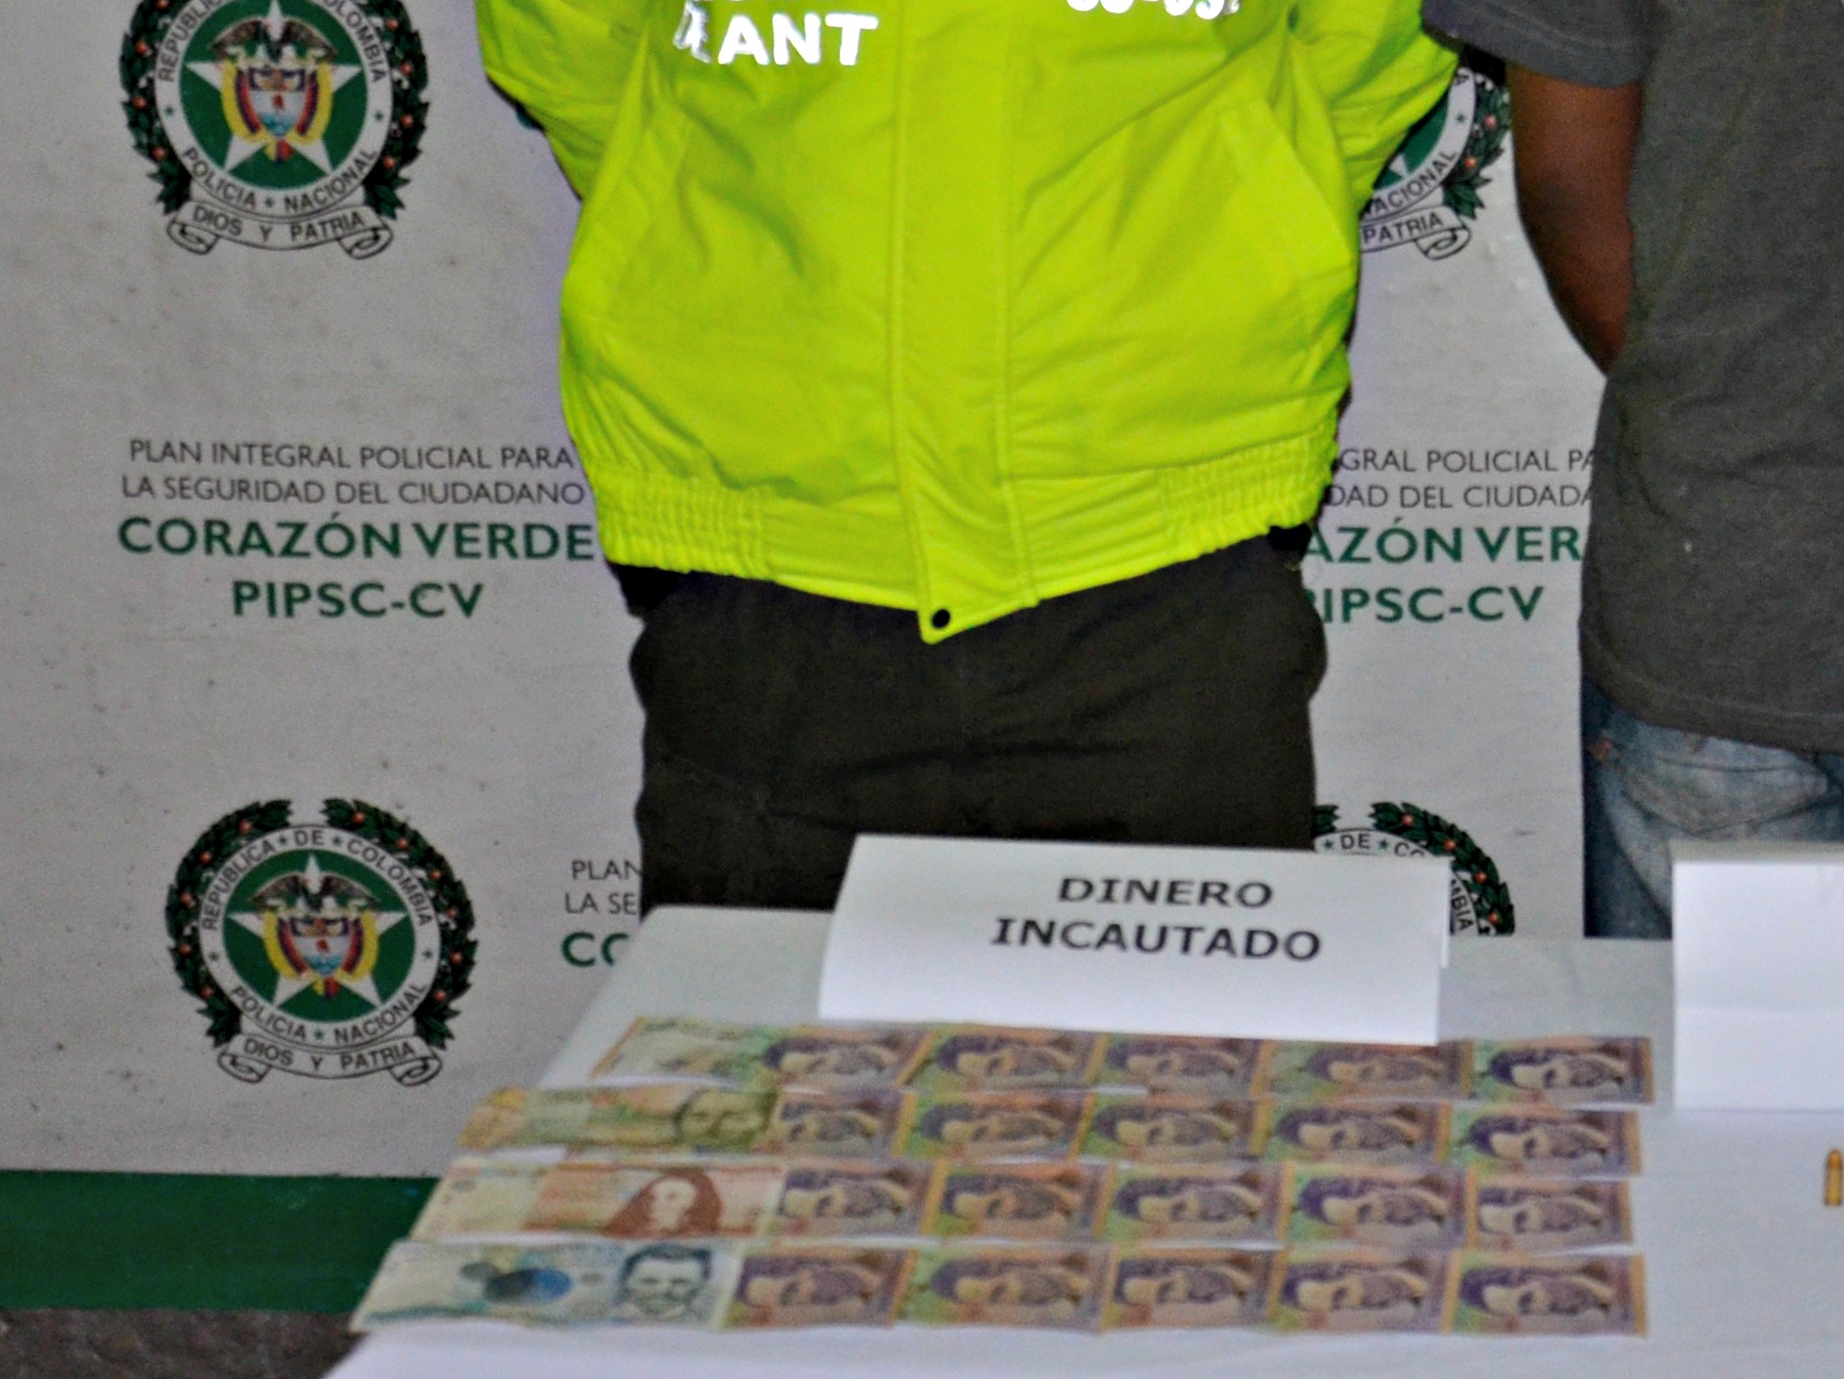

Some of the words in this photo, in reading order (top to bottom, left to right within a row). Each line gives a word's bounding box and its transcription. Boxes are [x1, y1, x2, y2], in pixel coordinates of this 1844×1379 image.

[183, 148, 256, 207] POLICIA
[285, 150, 376, 211] NACIONAL
[194, 206, 242, 235] DIOS
[291, 211, 364, 241] PATRIA
[1364, 213, 1443, 244] PATRIA
[130, 440, 200, 464] PLAN
[212, 443, 350, 469] INTEGRAL
[360, 446, 491, 470] POLICIAL
[500, 447, 575, 469] PARA
[1427, 450, 1557, 472] POLICIAL
[121, 477, 154, 498] LA
[164, 478, 325, 503] SEGURIDAD
[336, 482, 388, 504] DEL
[399, 483, 585, 505] CIUDADANO
[1401, 486, 1452, 508] DEL
[118, 512, 401, 558] CORAZÓN
[413, 523, 594, 561] VERDE
[232, 581, 484, 618] PIPSC-CV
[1341, 833, 1371, 849] DE
[203, 841, 275, 930] REPUBLICA
[295, 830, 325, 845] DE
[348, 839, 433, 926] COLOMBIA
[1058, 876, 1274, 907] DINERO
[566, 893, 599, 913] LA
[991, 918, 1322, 962] INCAUTADO
[232, 987, 306, 1037] POLICIA
[335, 984, 426, 1043] NACIONAL
[245, 1039, 293, 1065] DIOS
[341, 1042, 415, 1069] PATRIA
